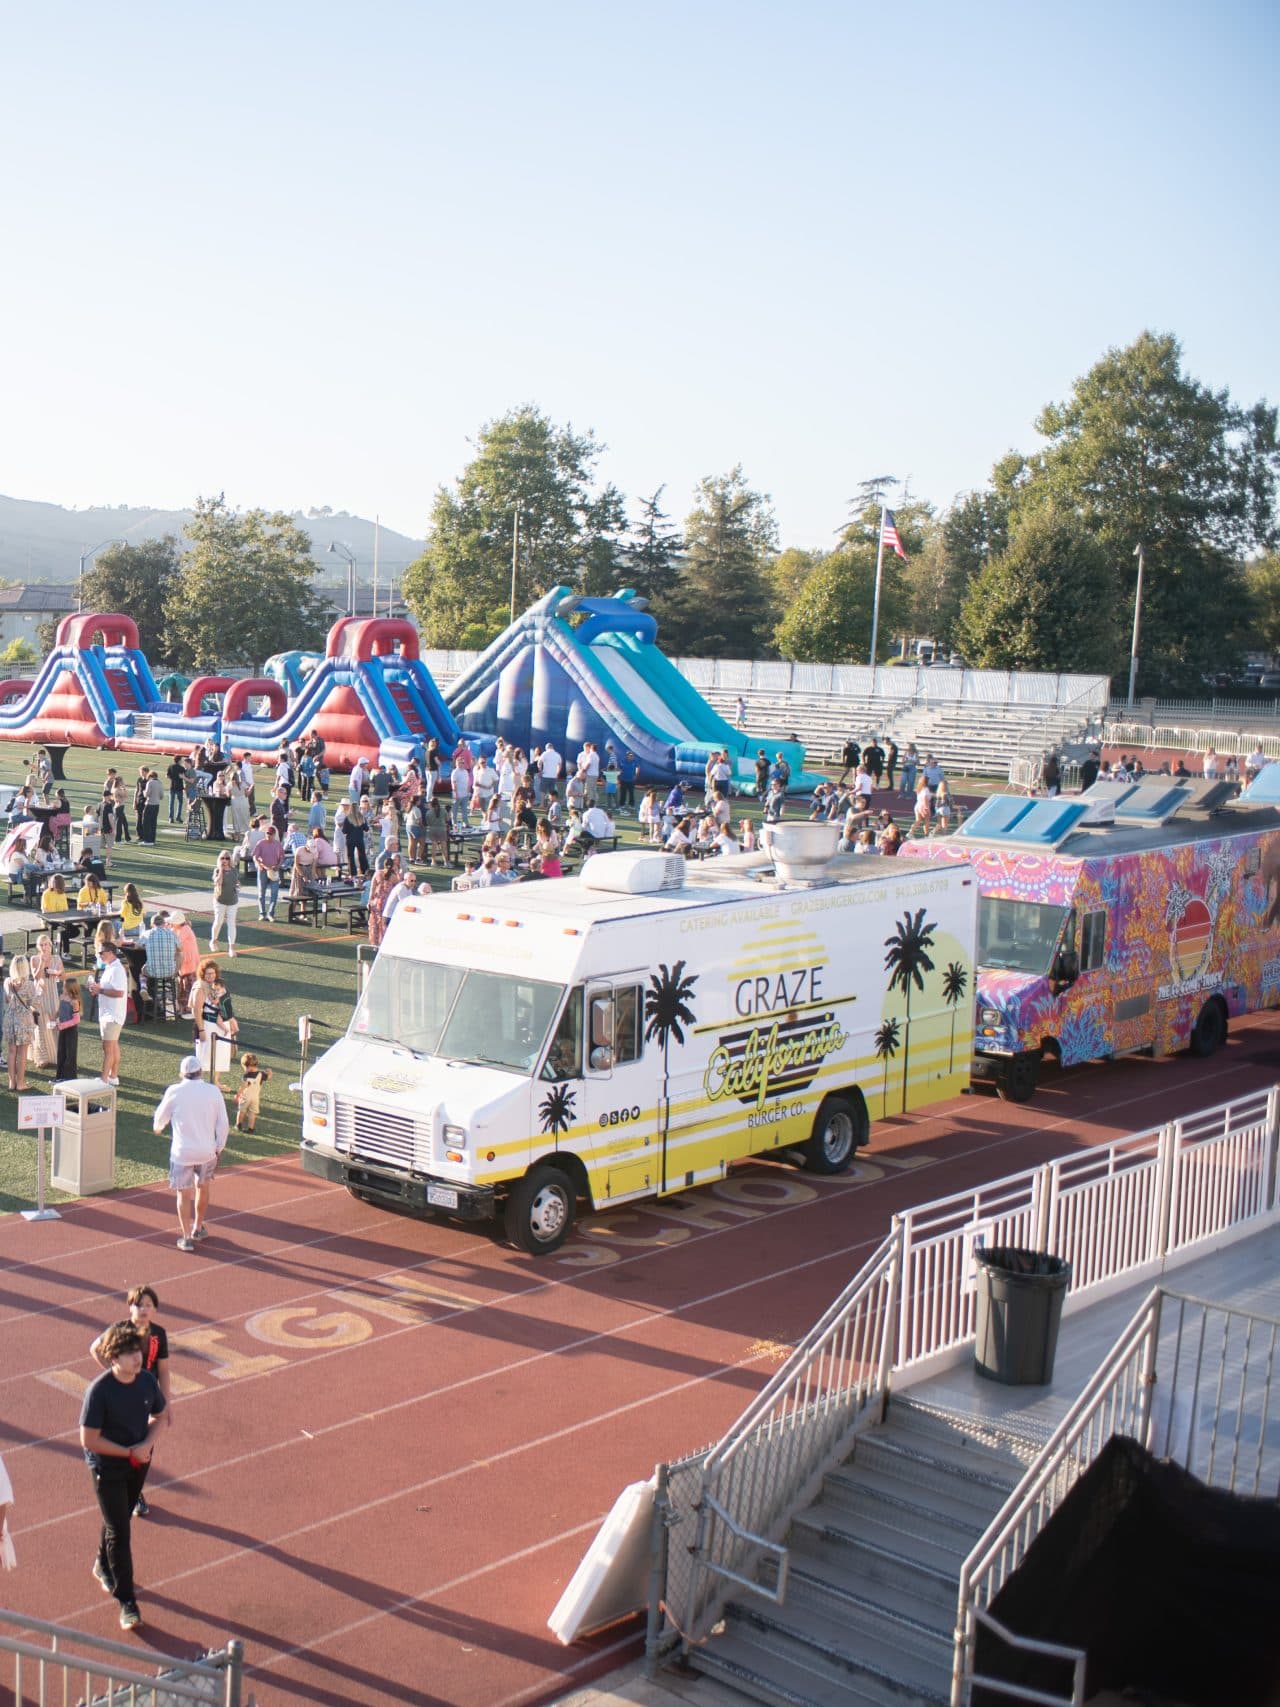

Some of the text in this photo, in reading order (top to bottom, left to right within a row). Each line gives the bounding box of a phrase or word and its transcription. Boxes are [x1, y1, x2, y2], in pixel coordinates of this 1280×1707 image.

[680, 911, 729, 933] CATERING
[731, 903, 780, 925] AVAILABLE
[735, 966, 824, 1017] GRAZE
[703, 1013, 850, 1111] California
[748, 1101, 807, 1128] BURGER CO.
